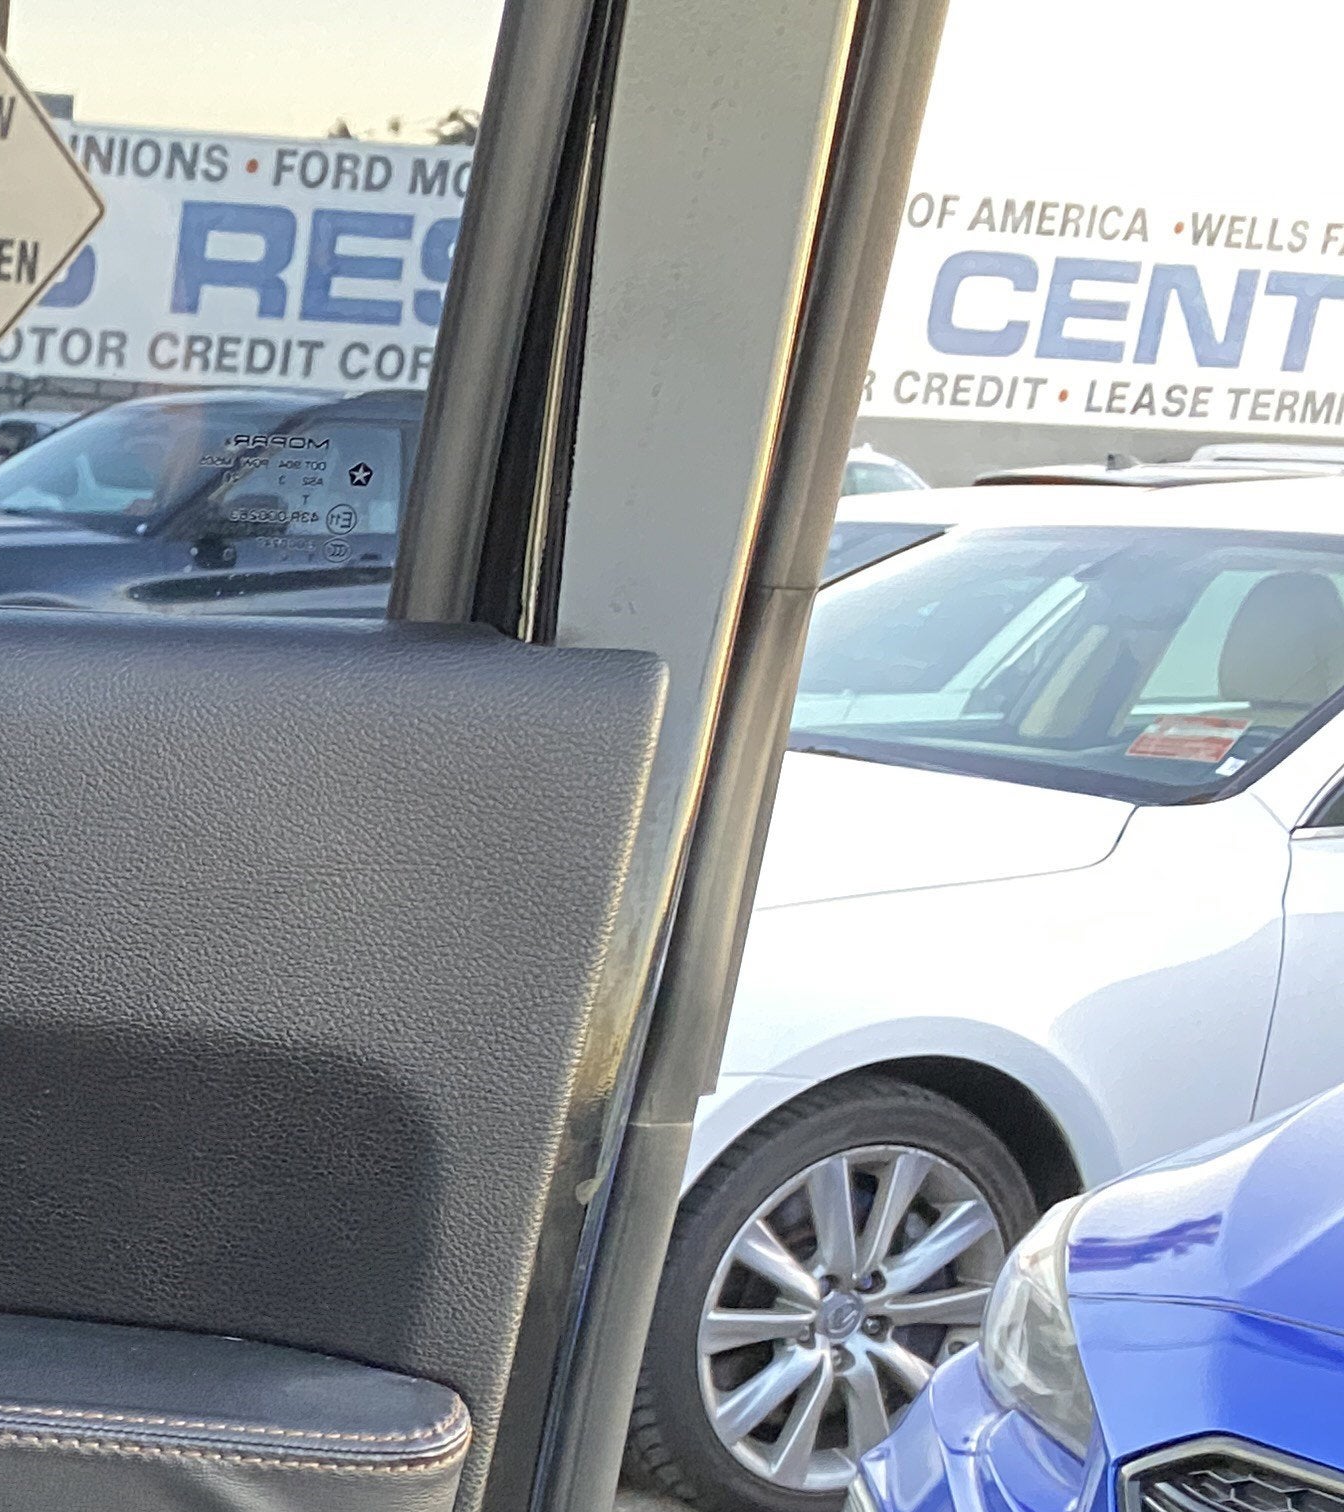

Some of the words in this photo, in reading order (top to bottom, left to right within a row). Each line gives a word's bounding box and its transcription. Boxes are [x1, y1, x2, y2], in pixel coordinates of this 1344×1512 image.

[69, 134, 230, 183] NIONS
[272, 147, 393, 194] FORD
[906, 192, 960, 229] OF
[968, 196, 1150, 243] AMERICA
[1191, 211, 1310, 253] WELLS
[147, 333, 330, 382] CREDIT
[893, 370, 1049, 413] CREDIT
[1085, 379, 1214, 419] LEASE
